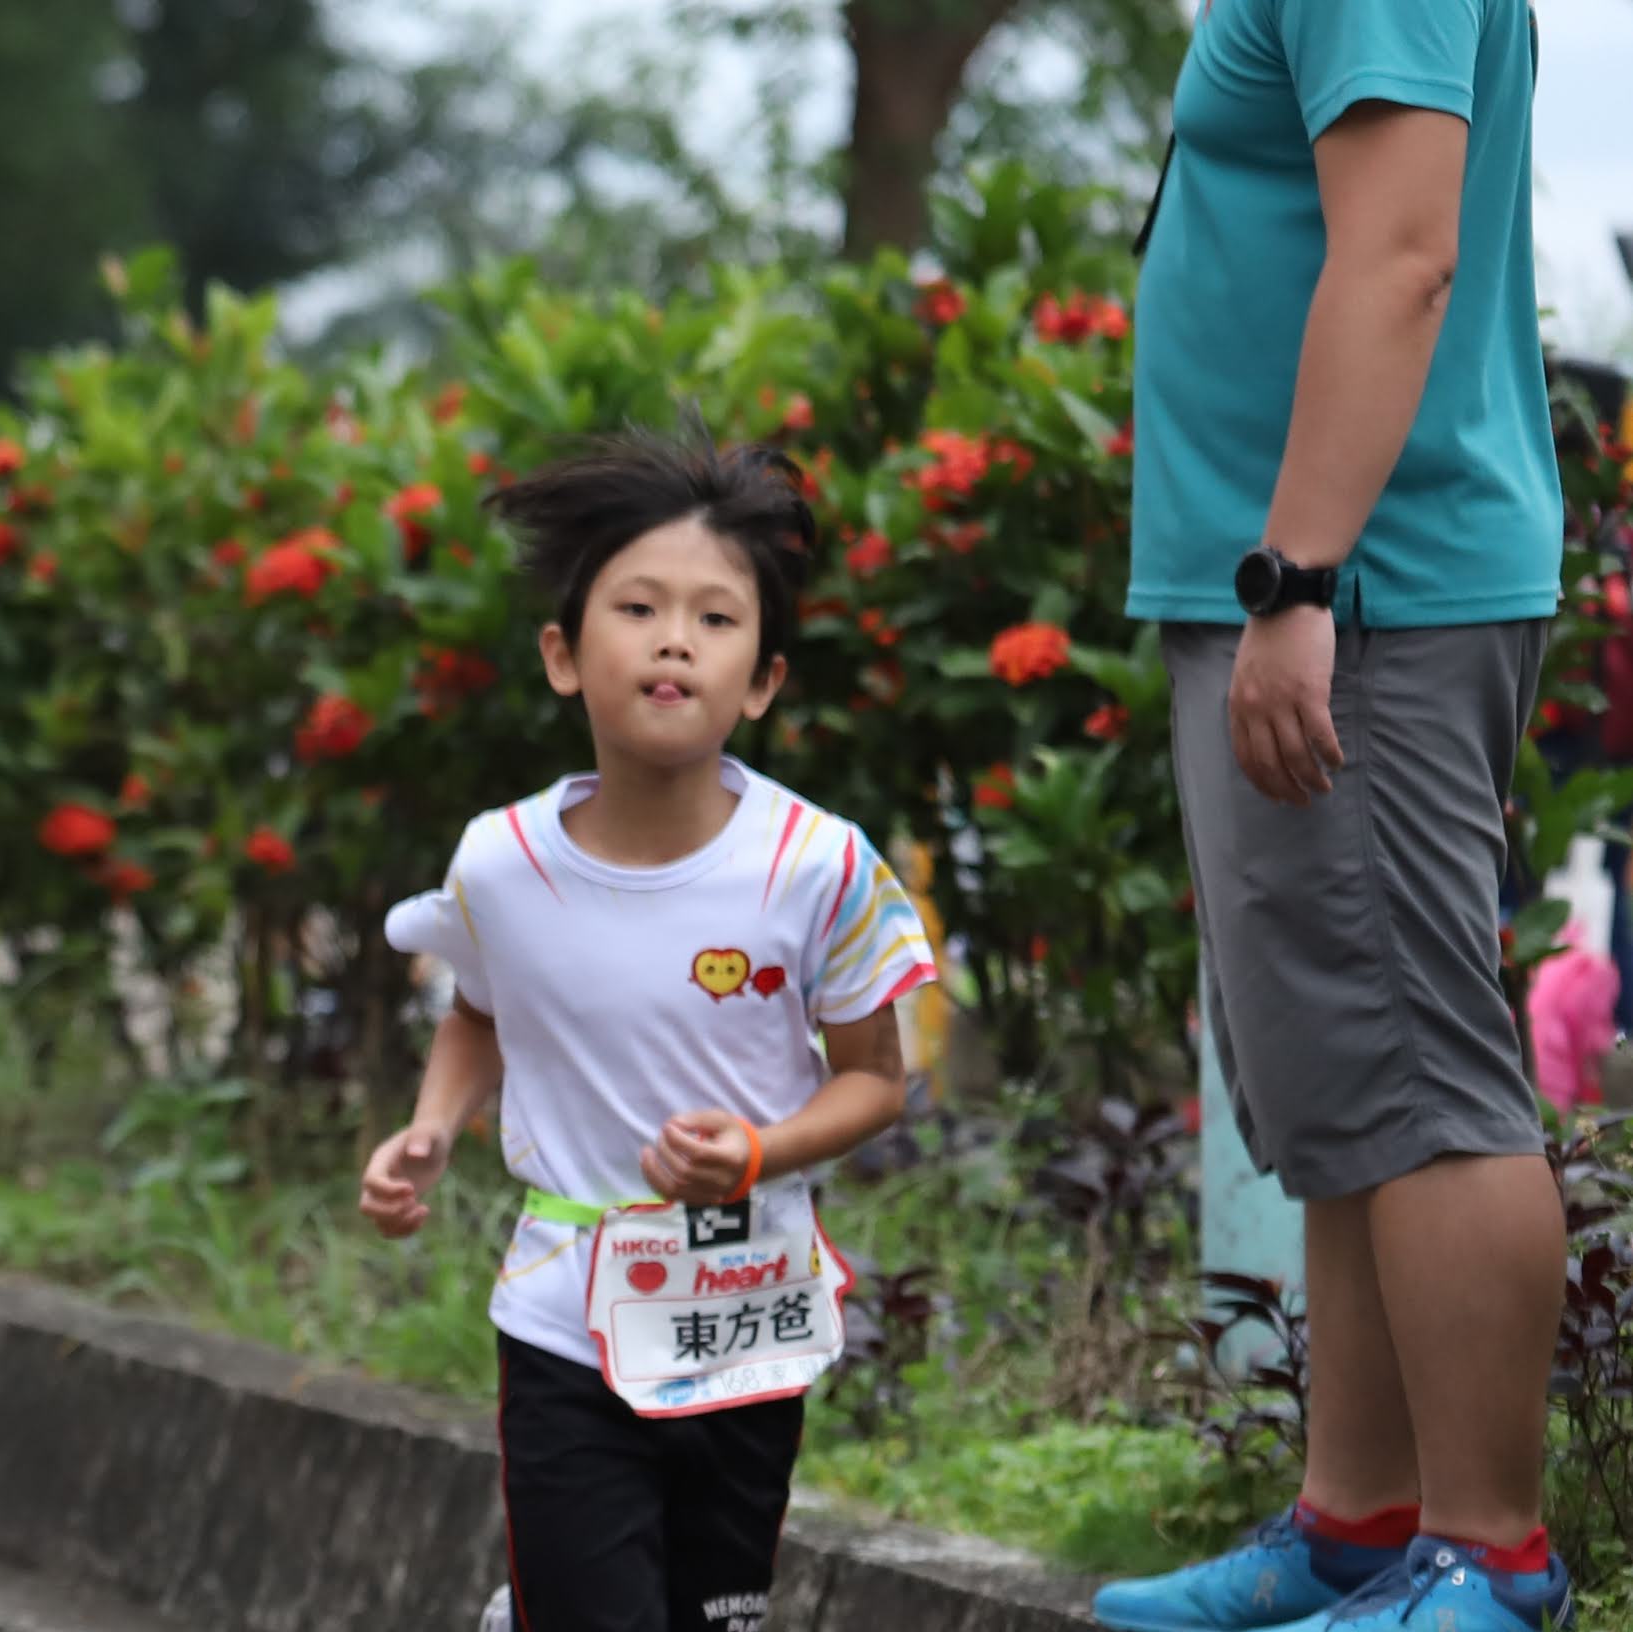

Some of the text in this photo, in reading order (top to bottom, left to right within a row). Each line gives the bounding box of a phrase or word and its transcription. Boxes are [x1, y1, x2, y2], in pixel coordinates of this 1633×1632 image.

[612, 1239, 679, 1257] HKCC
[693, 1252, 789, 1295] heart
[671, 1292, 814, 1361] 東方爸
